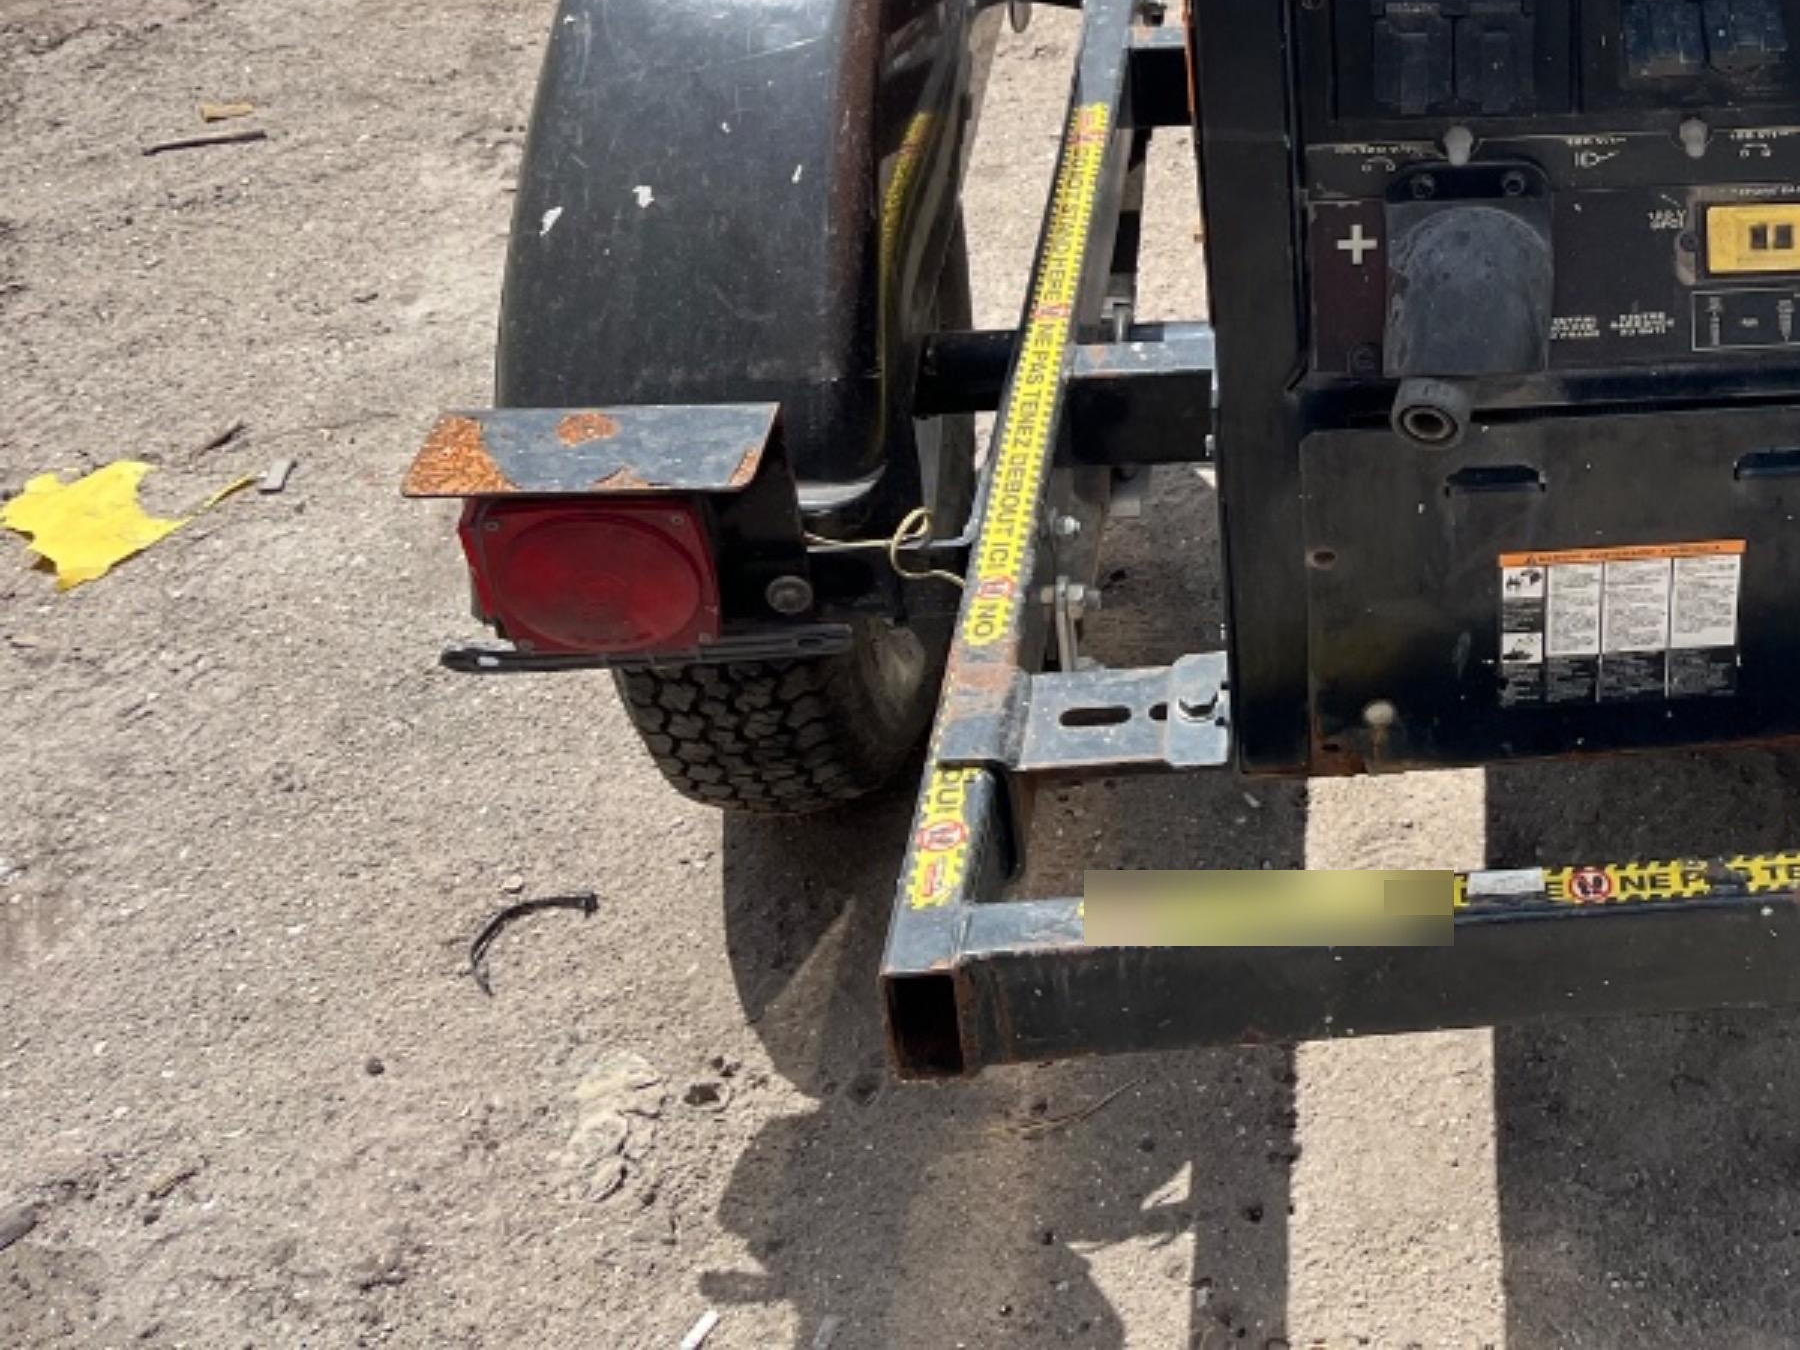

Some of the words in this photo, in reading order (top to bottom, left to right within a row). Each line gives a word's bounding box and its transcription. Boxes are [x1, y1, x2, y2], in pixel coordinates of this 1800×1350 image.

[1043, 256, 1067, 302] HERE
[1033, 323, 1055, 349] NE
[1025, 350, 1049, 385] PAS
[1016, 388, 1042, 448] TENEZ
[994, 456, 1027, 538] DEBOUT
[974, 601, 998, 637] NO
[1619, 872, 1672, 893] NE
